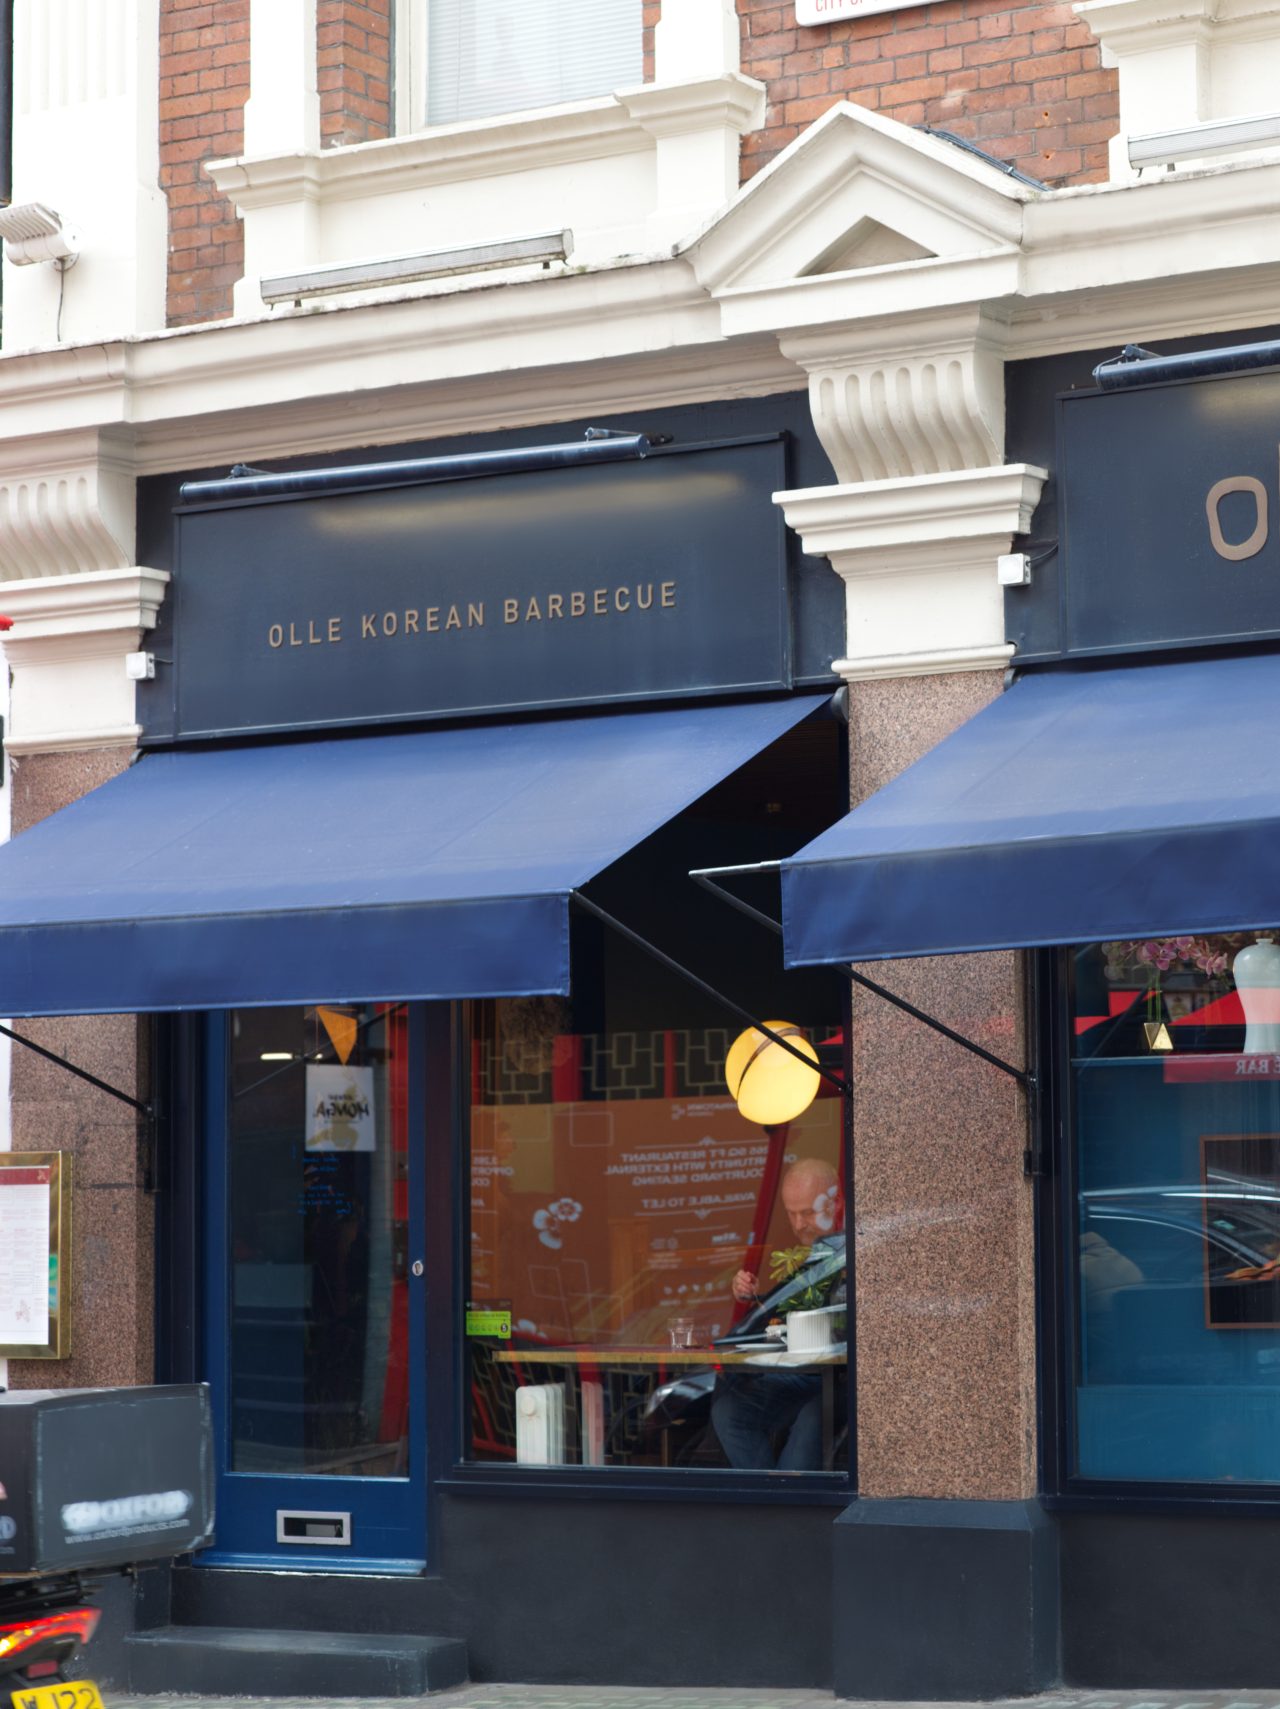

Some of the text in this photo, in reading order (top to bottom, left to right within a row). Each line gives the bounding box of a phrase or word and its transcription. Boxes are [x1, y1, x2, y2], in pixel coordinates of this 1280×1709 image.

[267, 581, 677, 648] OLLE KOREAN BARBECUE
